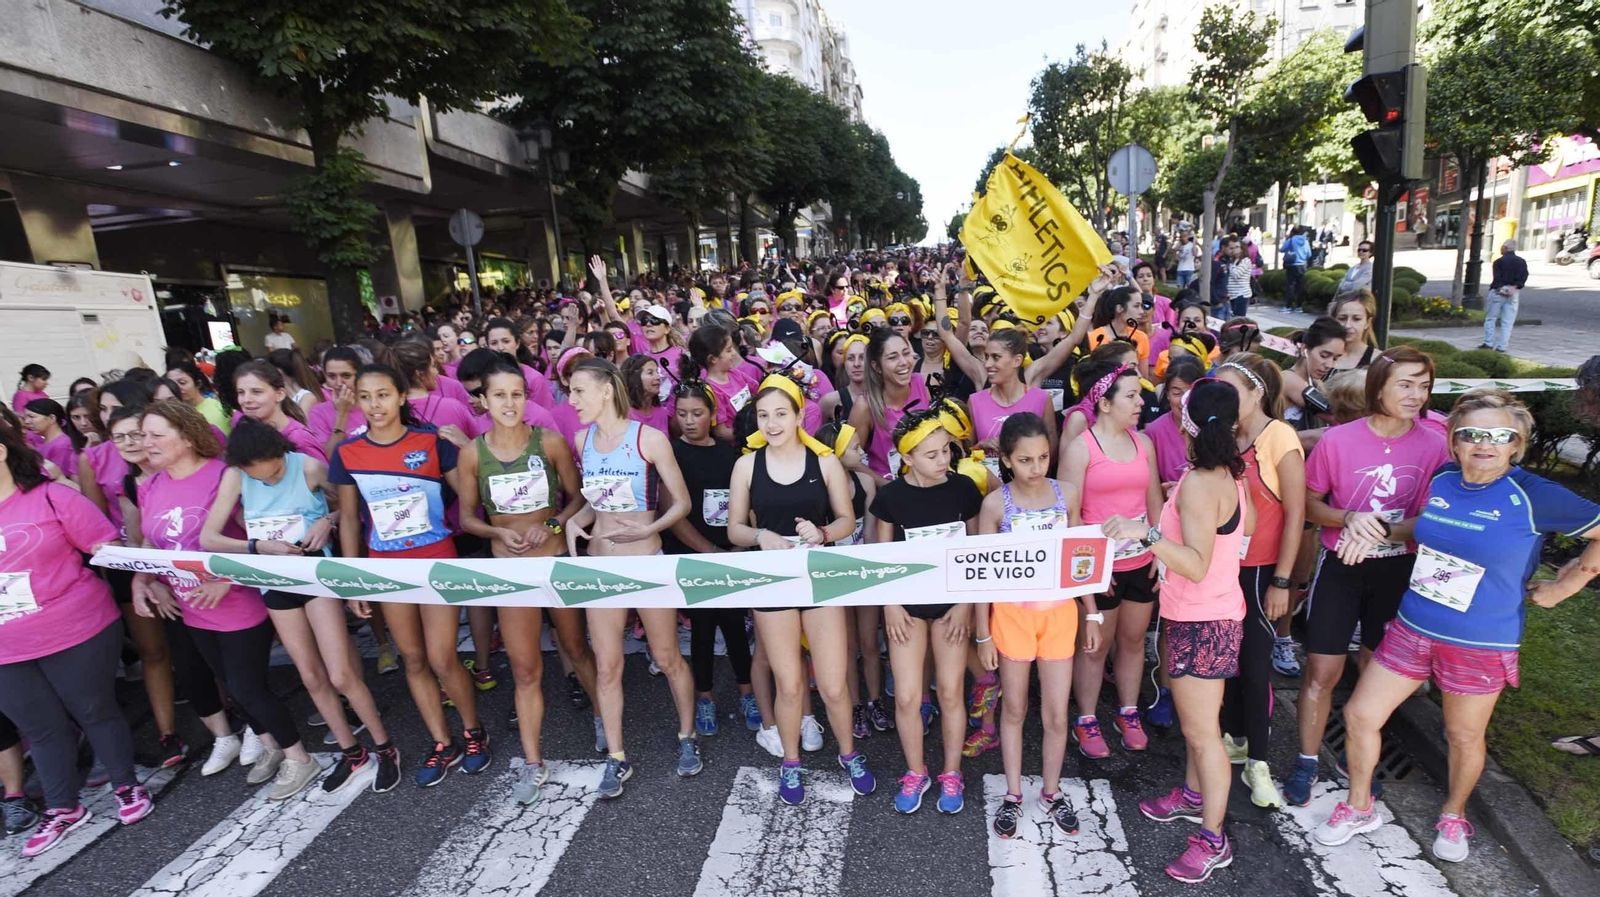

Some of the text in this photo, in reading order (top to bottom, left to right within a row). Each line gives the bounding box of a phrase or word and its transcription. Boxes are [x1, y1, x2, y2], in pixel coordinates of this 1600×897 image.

[513, 486, 528, 497] 143
[267, 530, 283, 541] 223
[954, 549, 1047, 564] CONCELLO
[860, 565, 908, 580] Inglés
[966, 566, 1035, 580] DE VIGO
[1433, 567, 1452, 583] 295
[321, 577, 336, 587] El
[358, 576, 400, 592] Inglés
[431, 580, 444, 590] El
[472, 578, 516, 593] Inglés
[553, 581, 568, 591] El
[597, 577, 642, 593] Inglés
[679, 577, 695, 587] El
[726, 574, 772, 586] Inglés
